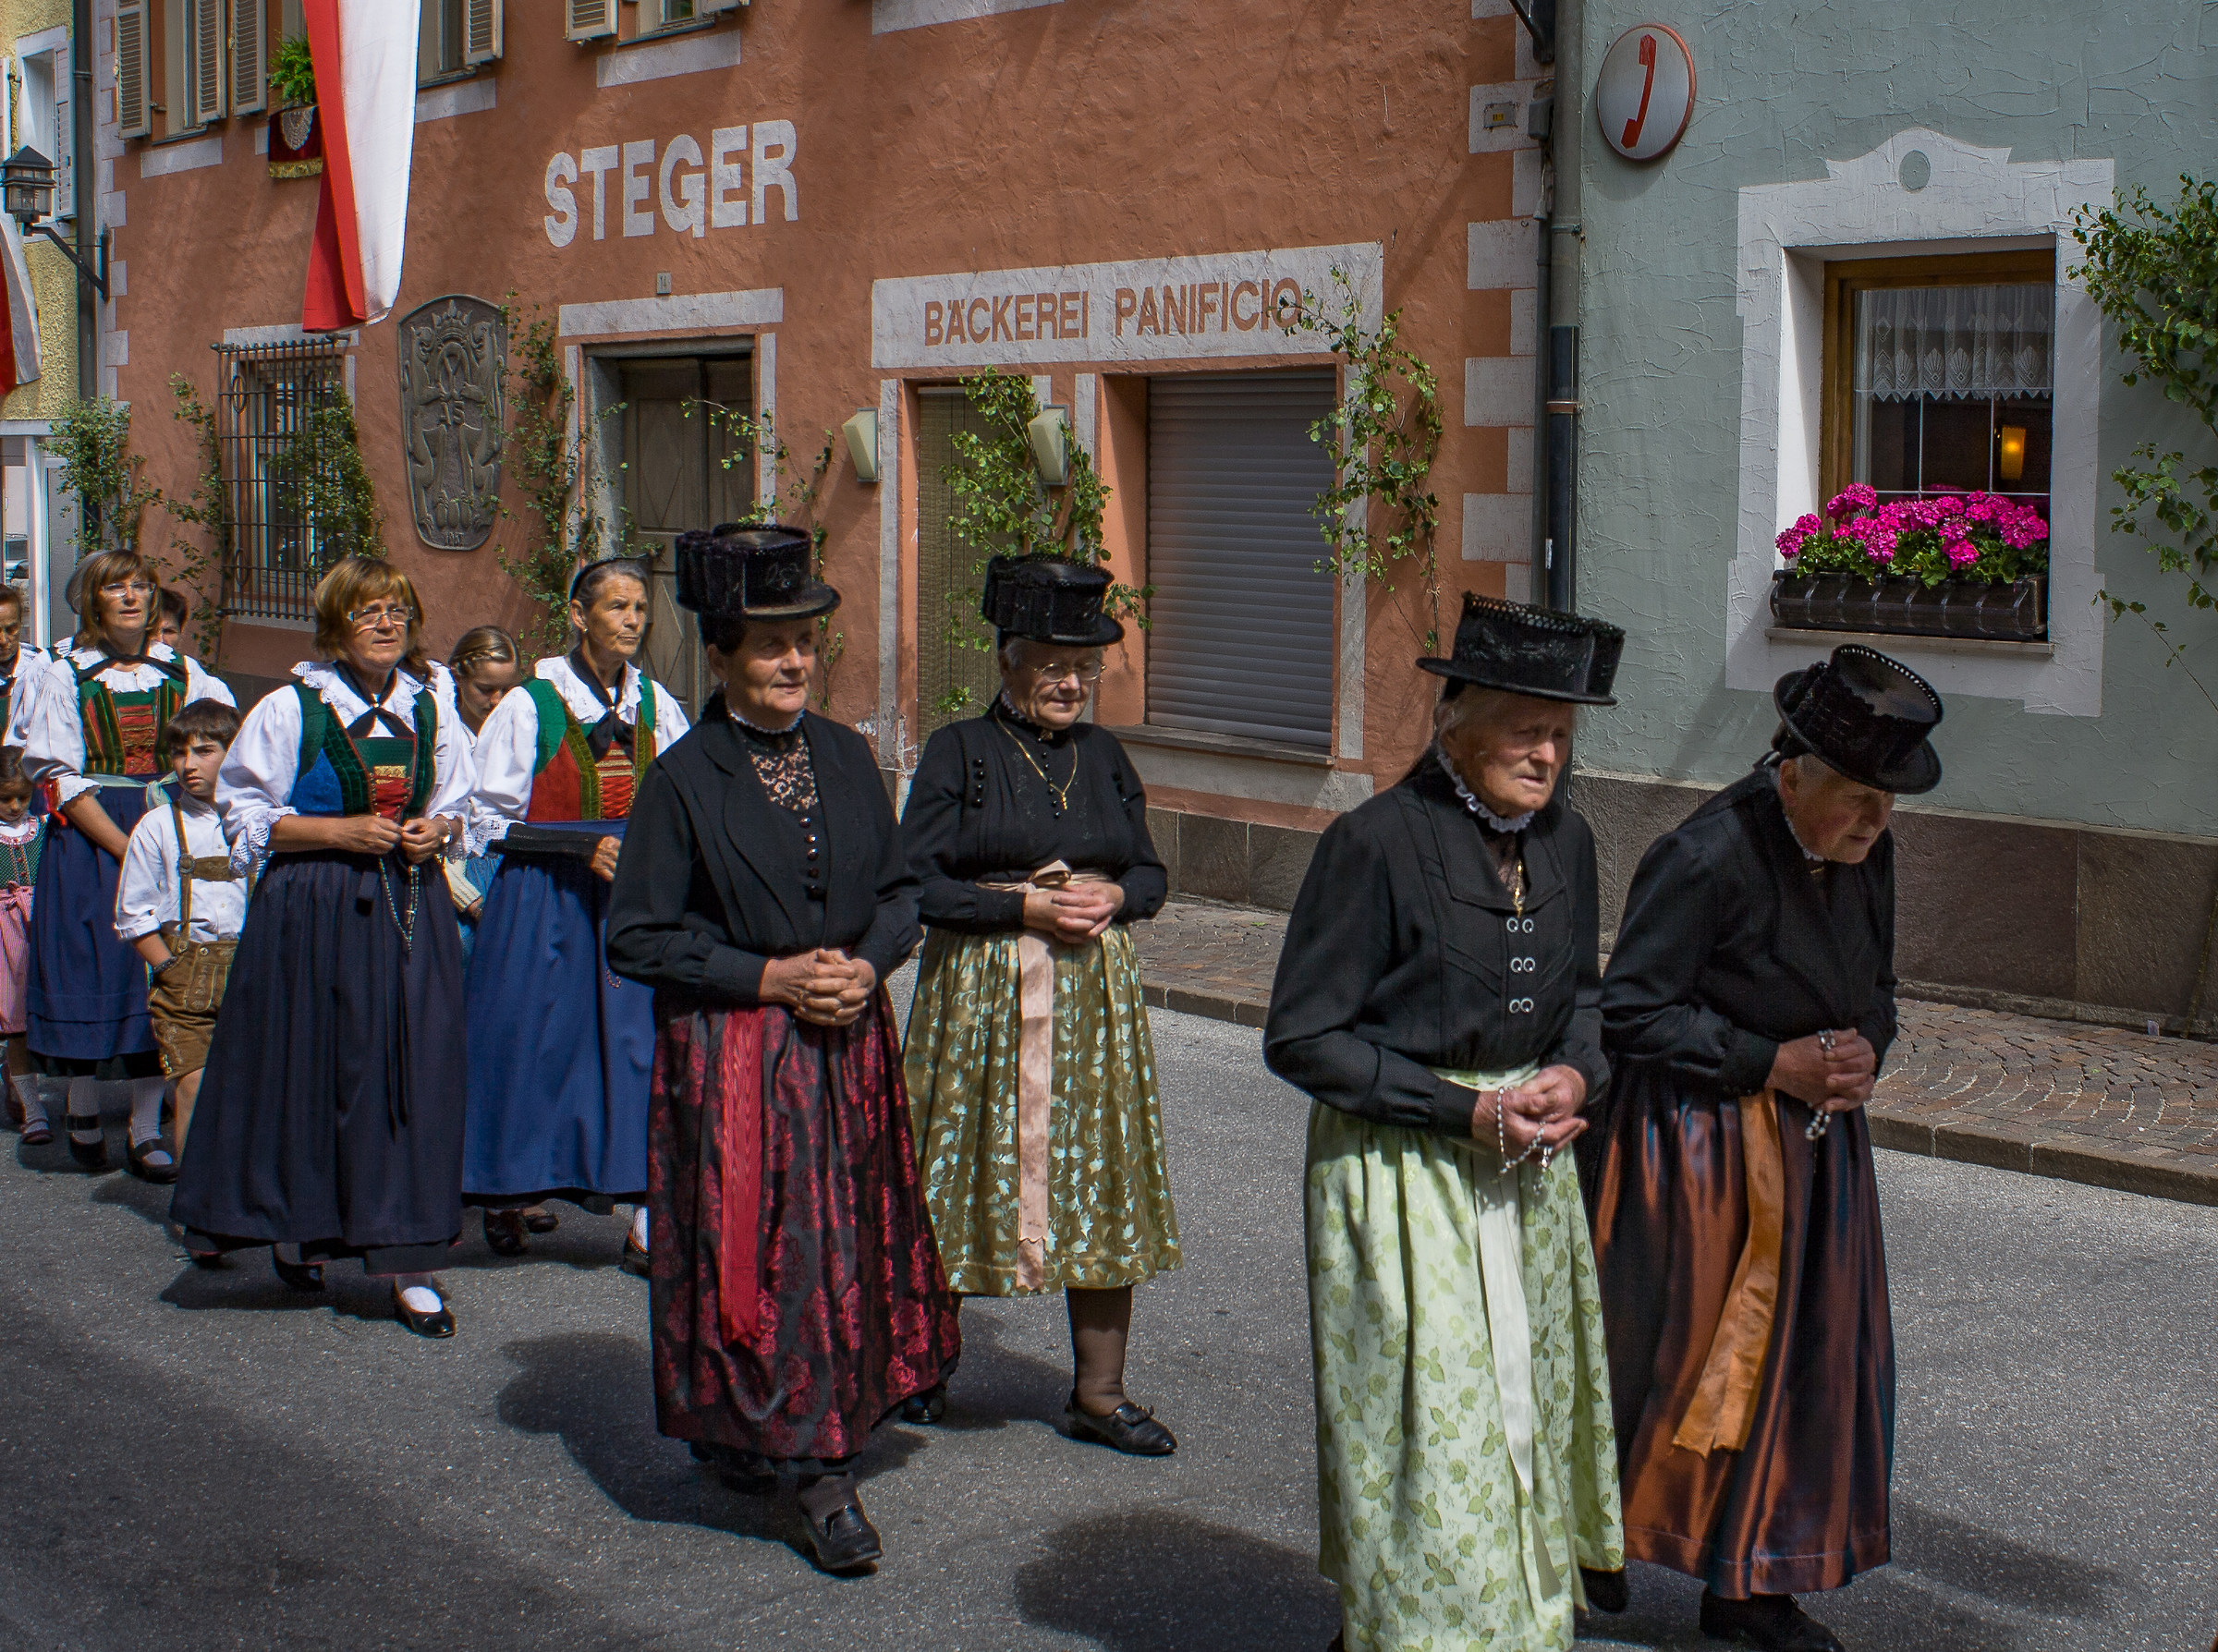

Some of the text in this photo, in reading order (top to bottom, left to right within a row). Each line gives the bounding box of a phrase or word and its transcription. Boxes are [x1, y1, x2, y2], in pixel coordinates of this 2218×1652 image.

[544, 119, 798, 248] STEGER
[924, 277, 1304, 346] BÄCKEREI PANIFICIO
